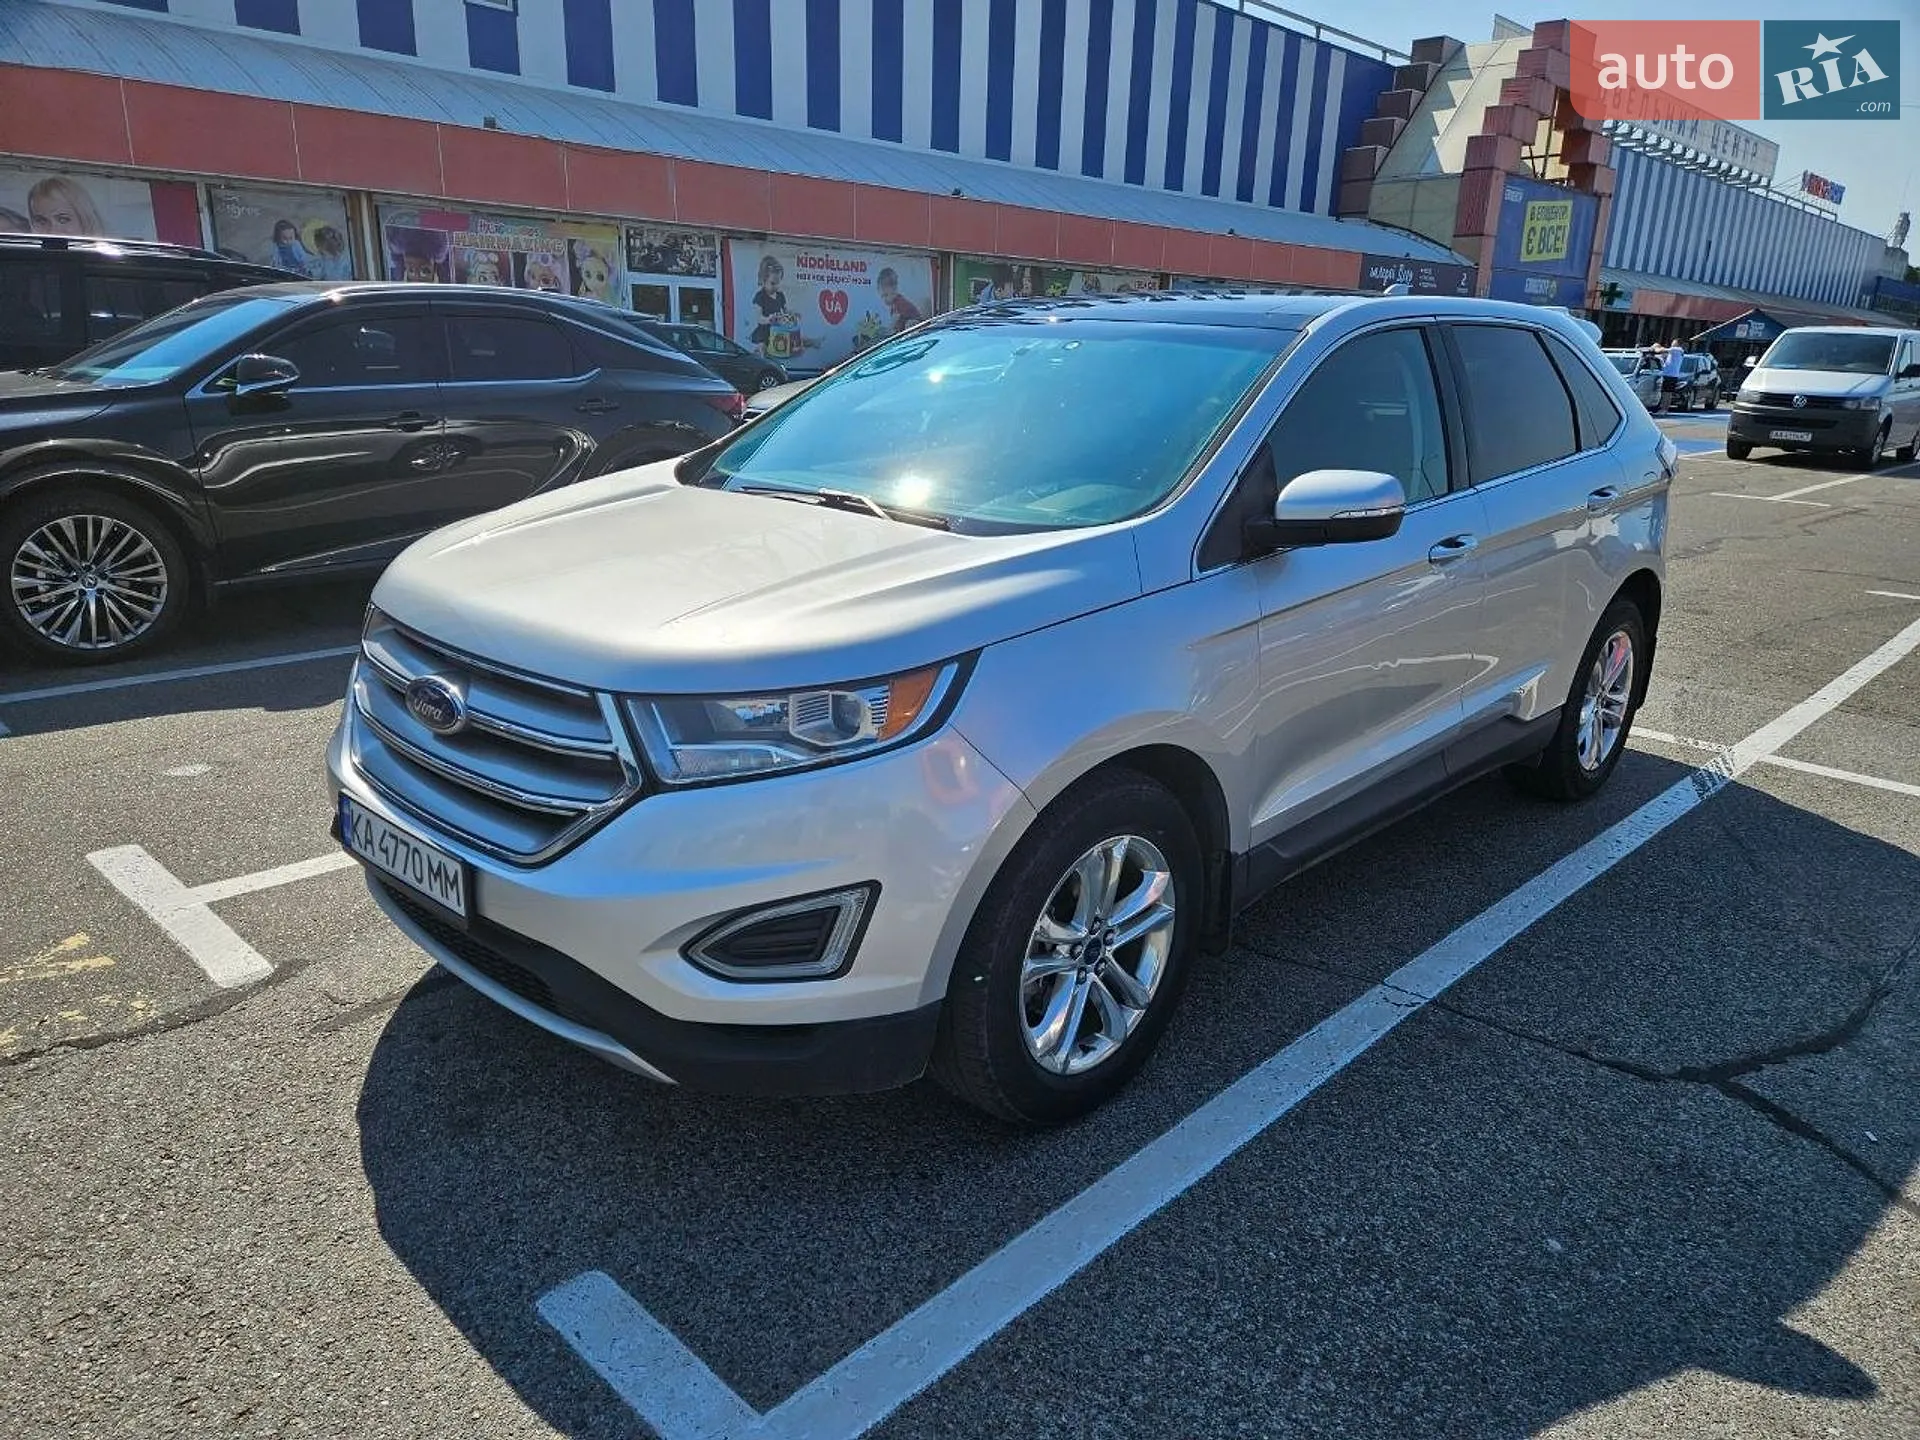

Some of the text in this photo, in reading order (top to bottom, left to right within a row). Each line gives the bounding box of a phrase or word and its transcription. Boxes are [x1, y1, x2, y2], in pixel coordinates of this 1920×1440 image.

[825, 298, 842, 313] UA
[350, 809, 462, 907] KA 4770 MM
